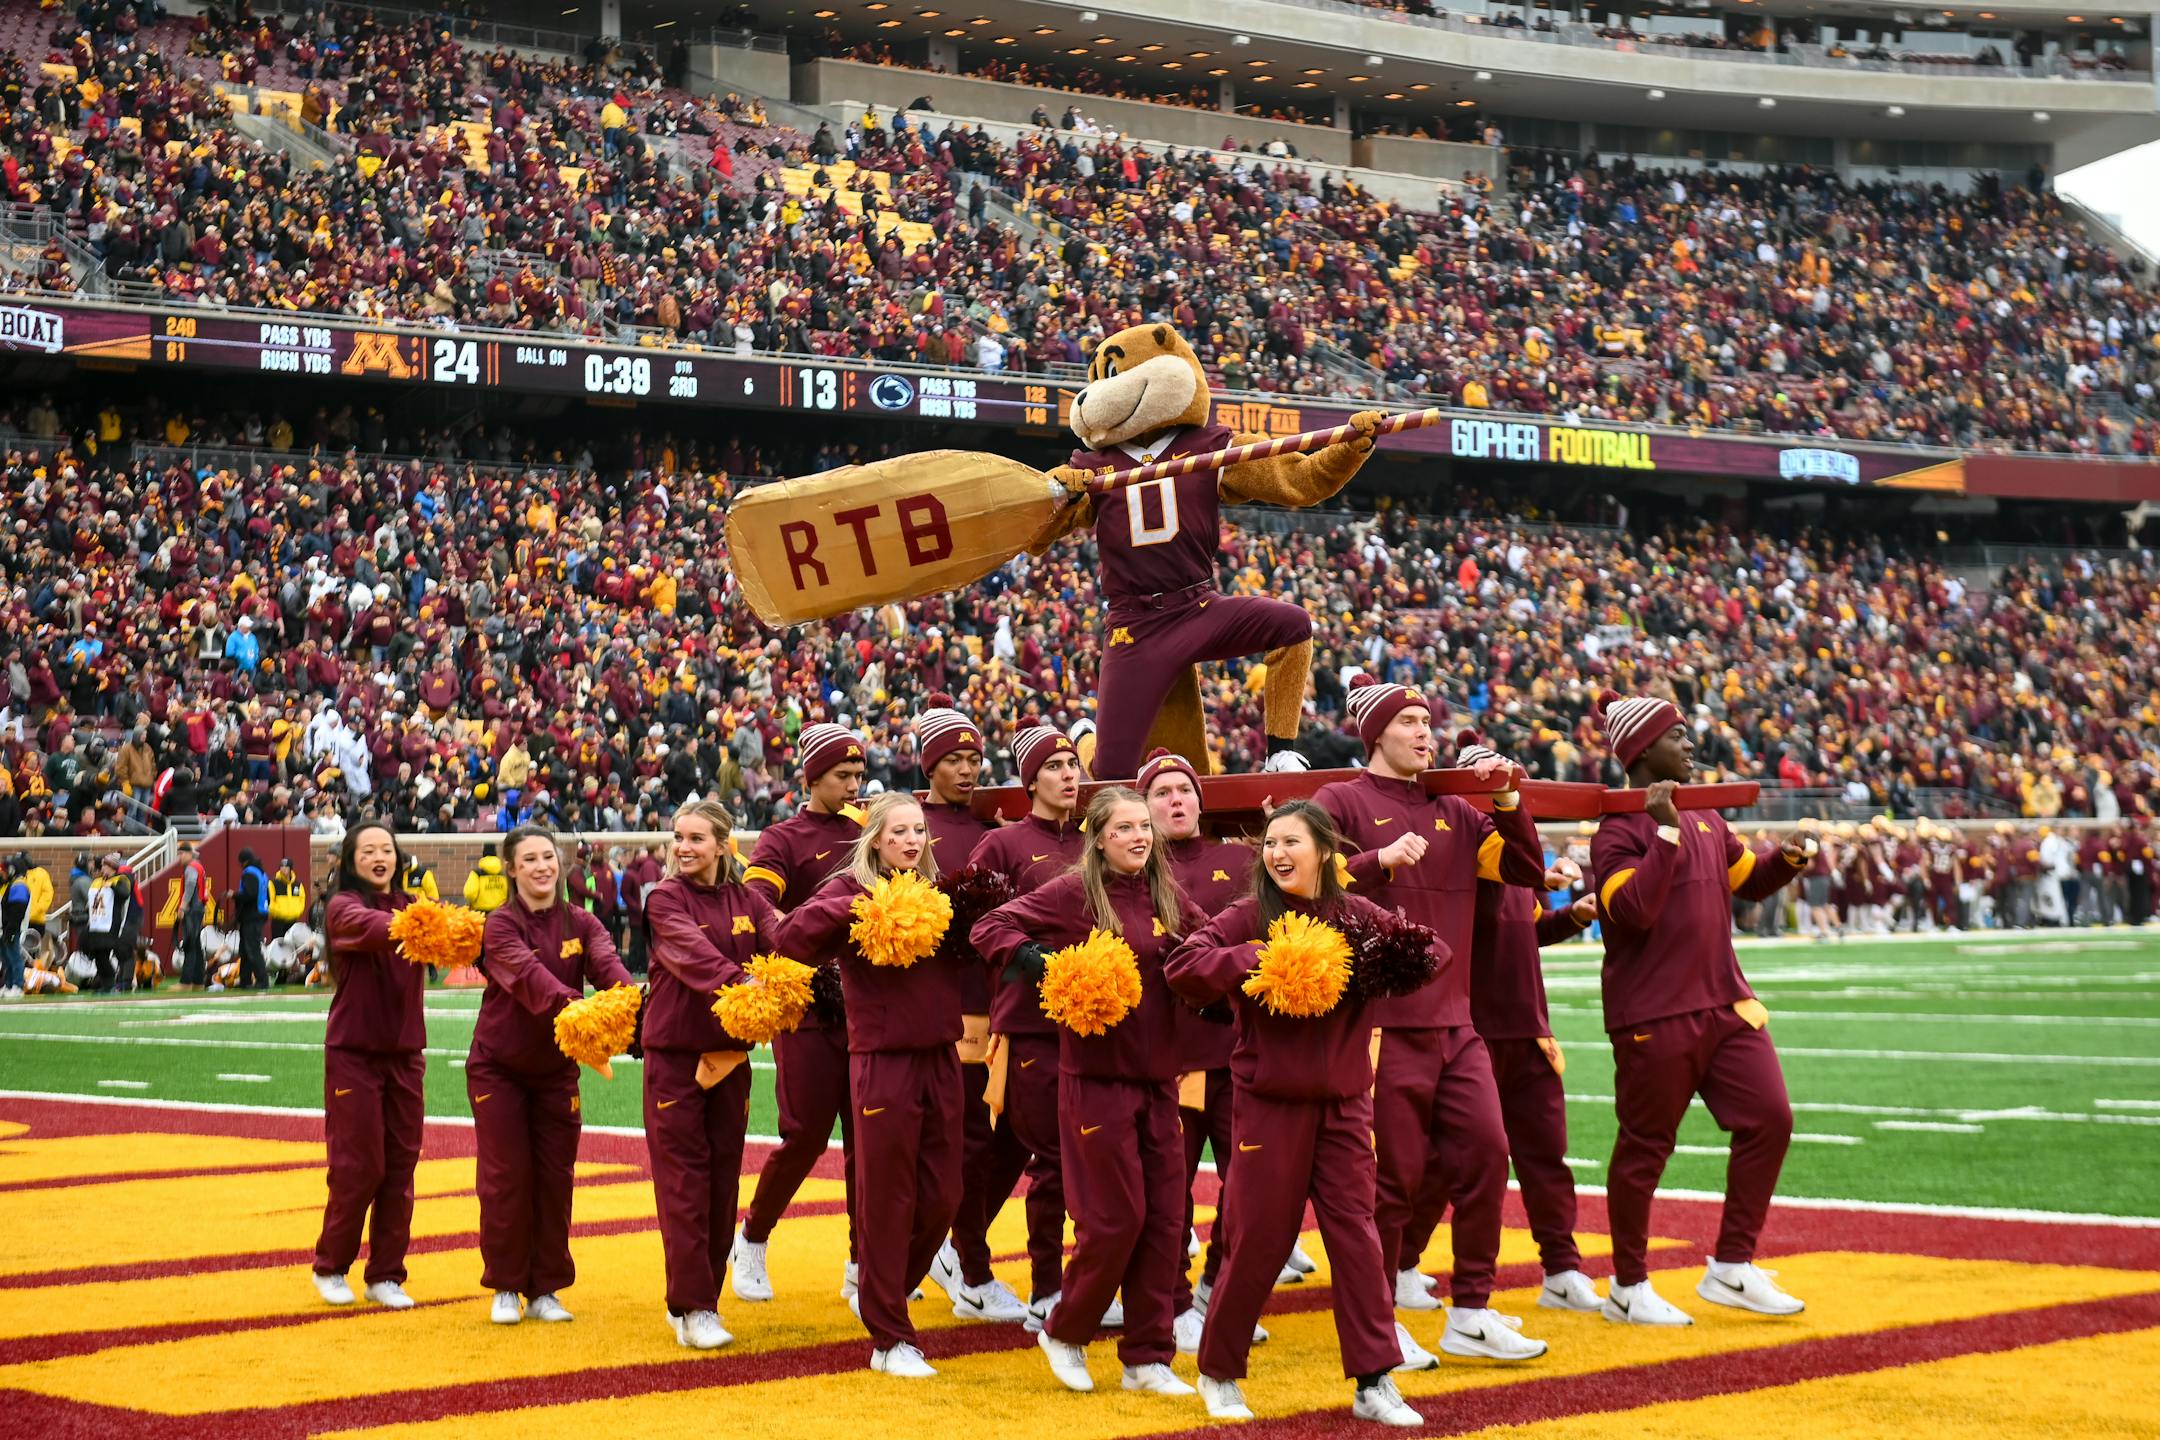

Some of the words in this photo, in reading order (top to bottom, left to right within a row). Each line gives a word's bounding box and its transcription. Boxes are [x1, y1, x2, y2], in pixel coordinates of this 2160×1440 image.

[1, 312, 58, 343] BOAT
[166, 316, 196, 338] 240
[260, 323, 299, 346] PASS
[303, 327, 332, 349] YDS
[166, 341, 186, 362] 81
[260, 349, 299, 372] RUSH
[303, 352, 332, 375] YDS
[433, 339, 480, 384] 24
[516, 346, 545, 365] BALL
[549, 349, 567, 366] ON
[585, 354, 651, 396] 0:39
[799, 368, 837, 410] 13
[919, 376, 951, 396] PASS
[952, 379, 977, 398] YDS
[1451, 418, 1540, 462] GOPHER
[1549, 426, 1656, 470] FOOTBALL
[779, 492, 953, 591] RTB
